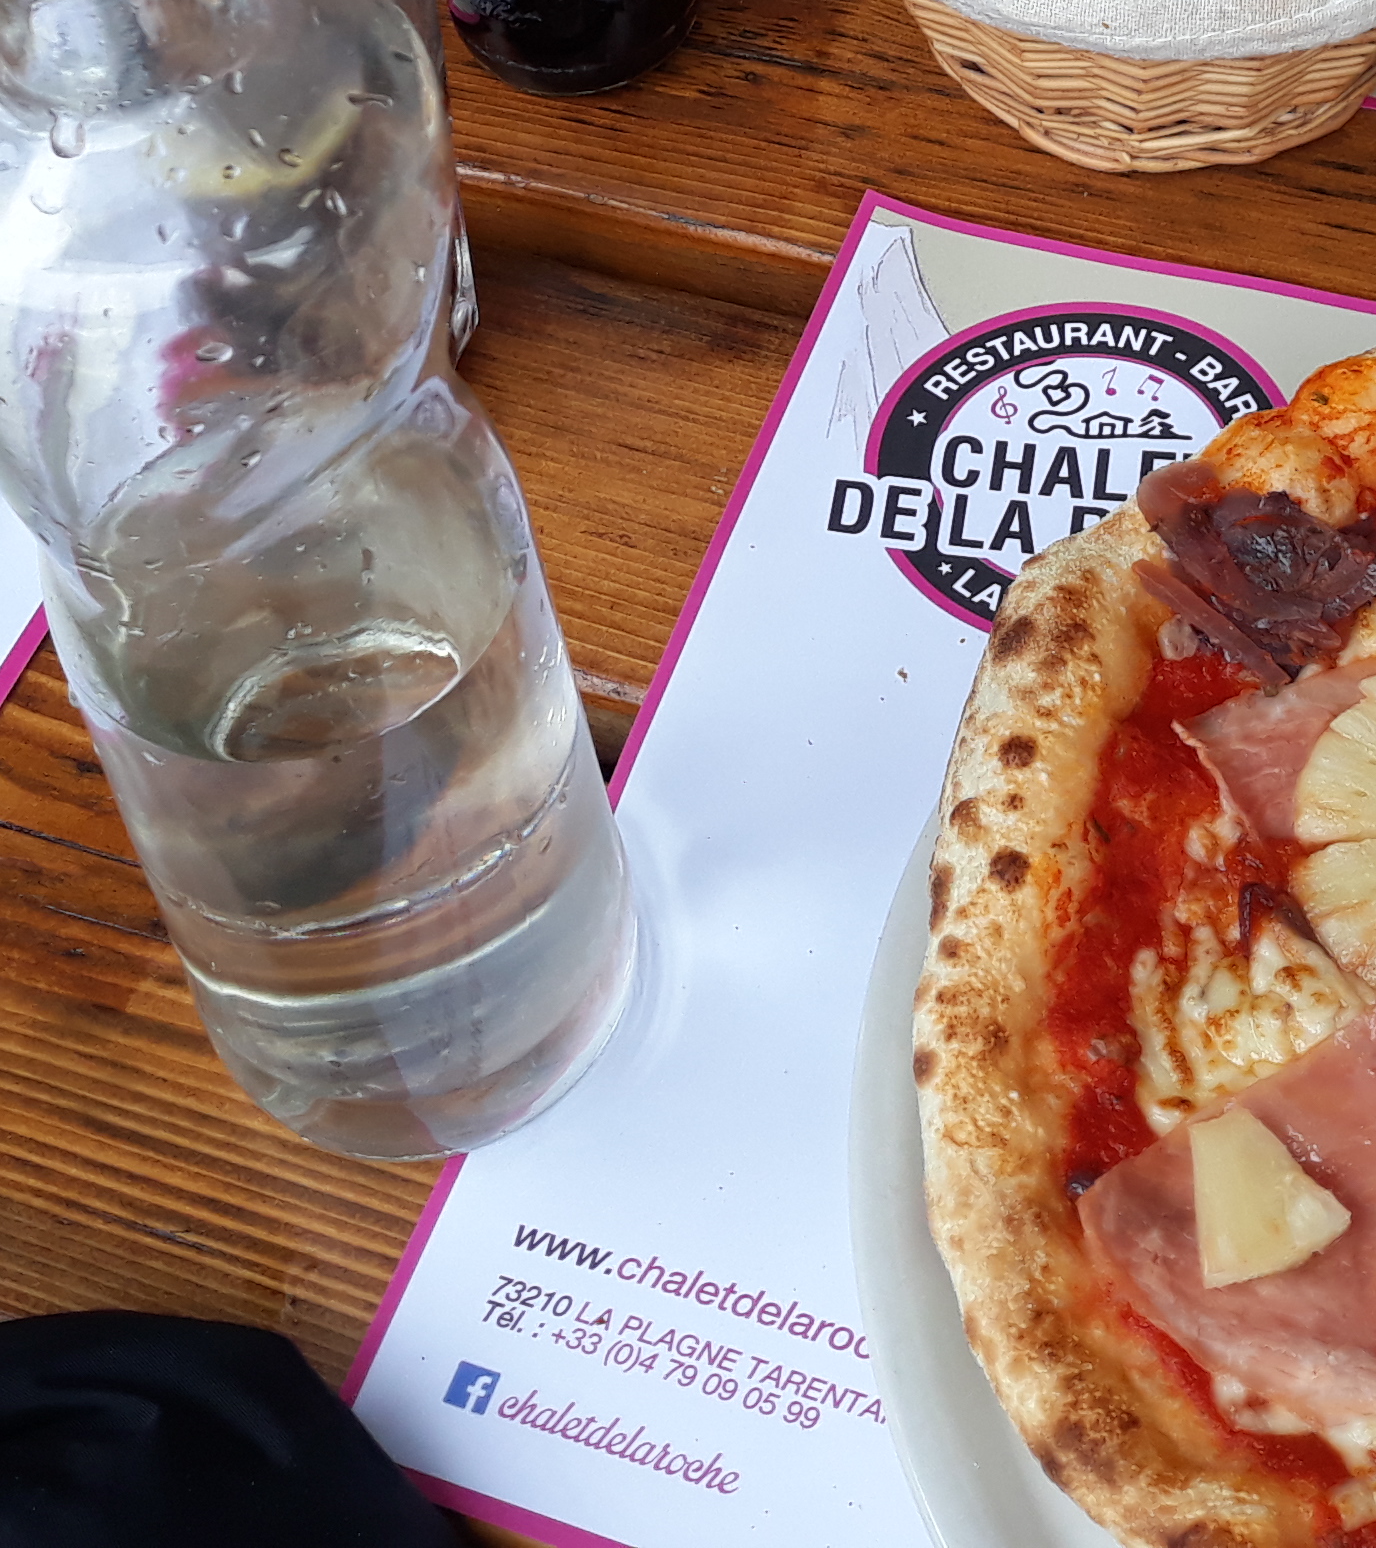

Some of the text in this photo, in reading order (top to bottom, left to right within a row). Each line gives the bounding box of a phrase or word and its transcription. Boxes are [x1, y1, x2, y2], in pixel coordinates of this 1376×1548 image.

[924, 322, 1175, 402] RESTAURANT
[1189, 354, 1261, 419] BAR
[827, 478, 923, 543] DE
[948, 493, 1035, 555] LA
[940, 434, 1197, 503] CHAL
[513, 1224, 871, 1359] www.chaletdelaroc
[482, 1299, 526, 1334] Tél.
[551, 1327, 603, 1355] +33
[603, 1339, 660, 1374] (0)4
[663, 1358, 698, 1387] 79
[702, 1373, 738, 1401] 09
[742, 1386, 781, 1415] 05
[782, 1400, 821, 1430] 99
[491, 1275, 887, 1424] 73210 LA PLAGNE TARENTA
[498, 1389, 740, 1494] chaletdelaroche
